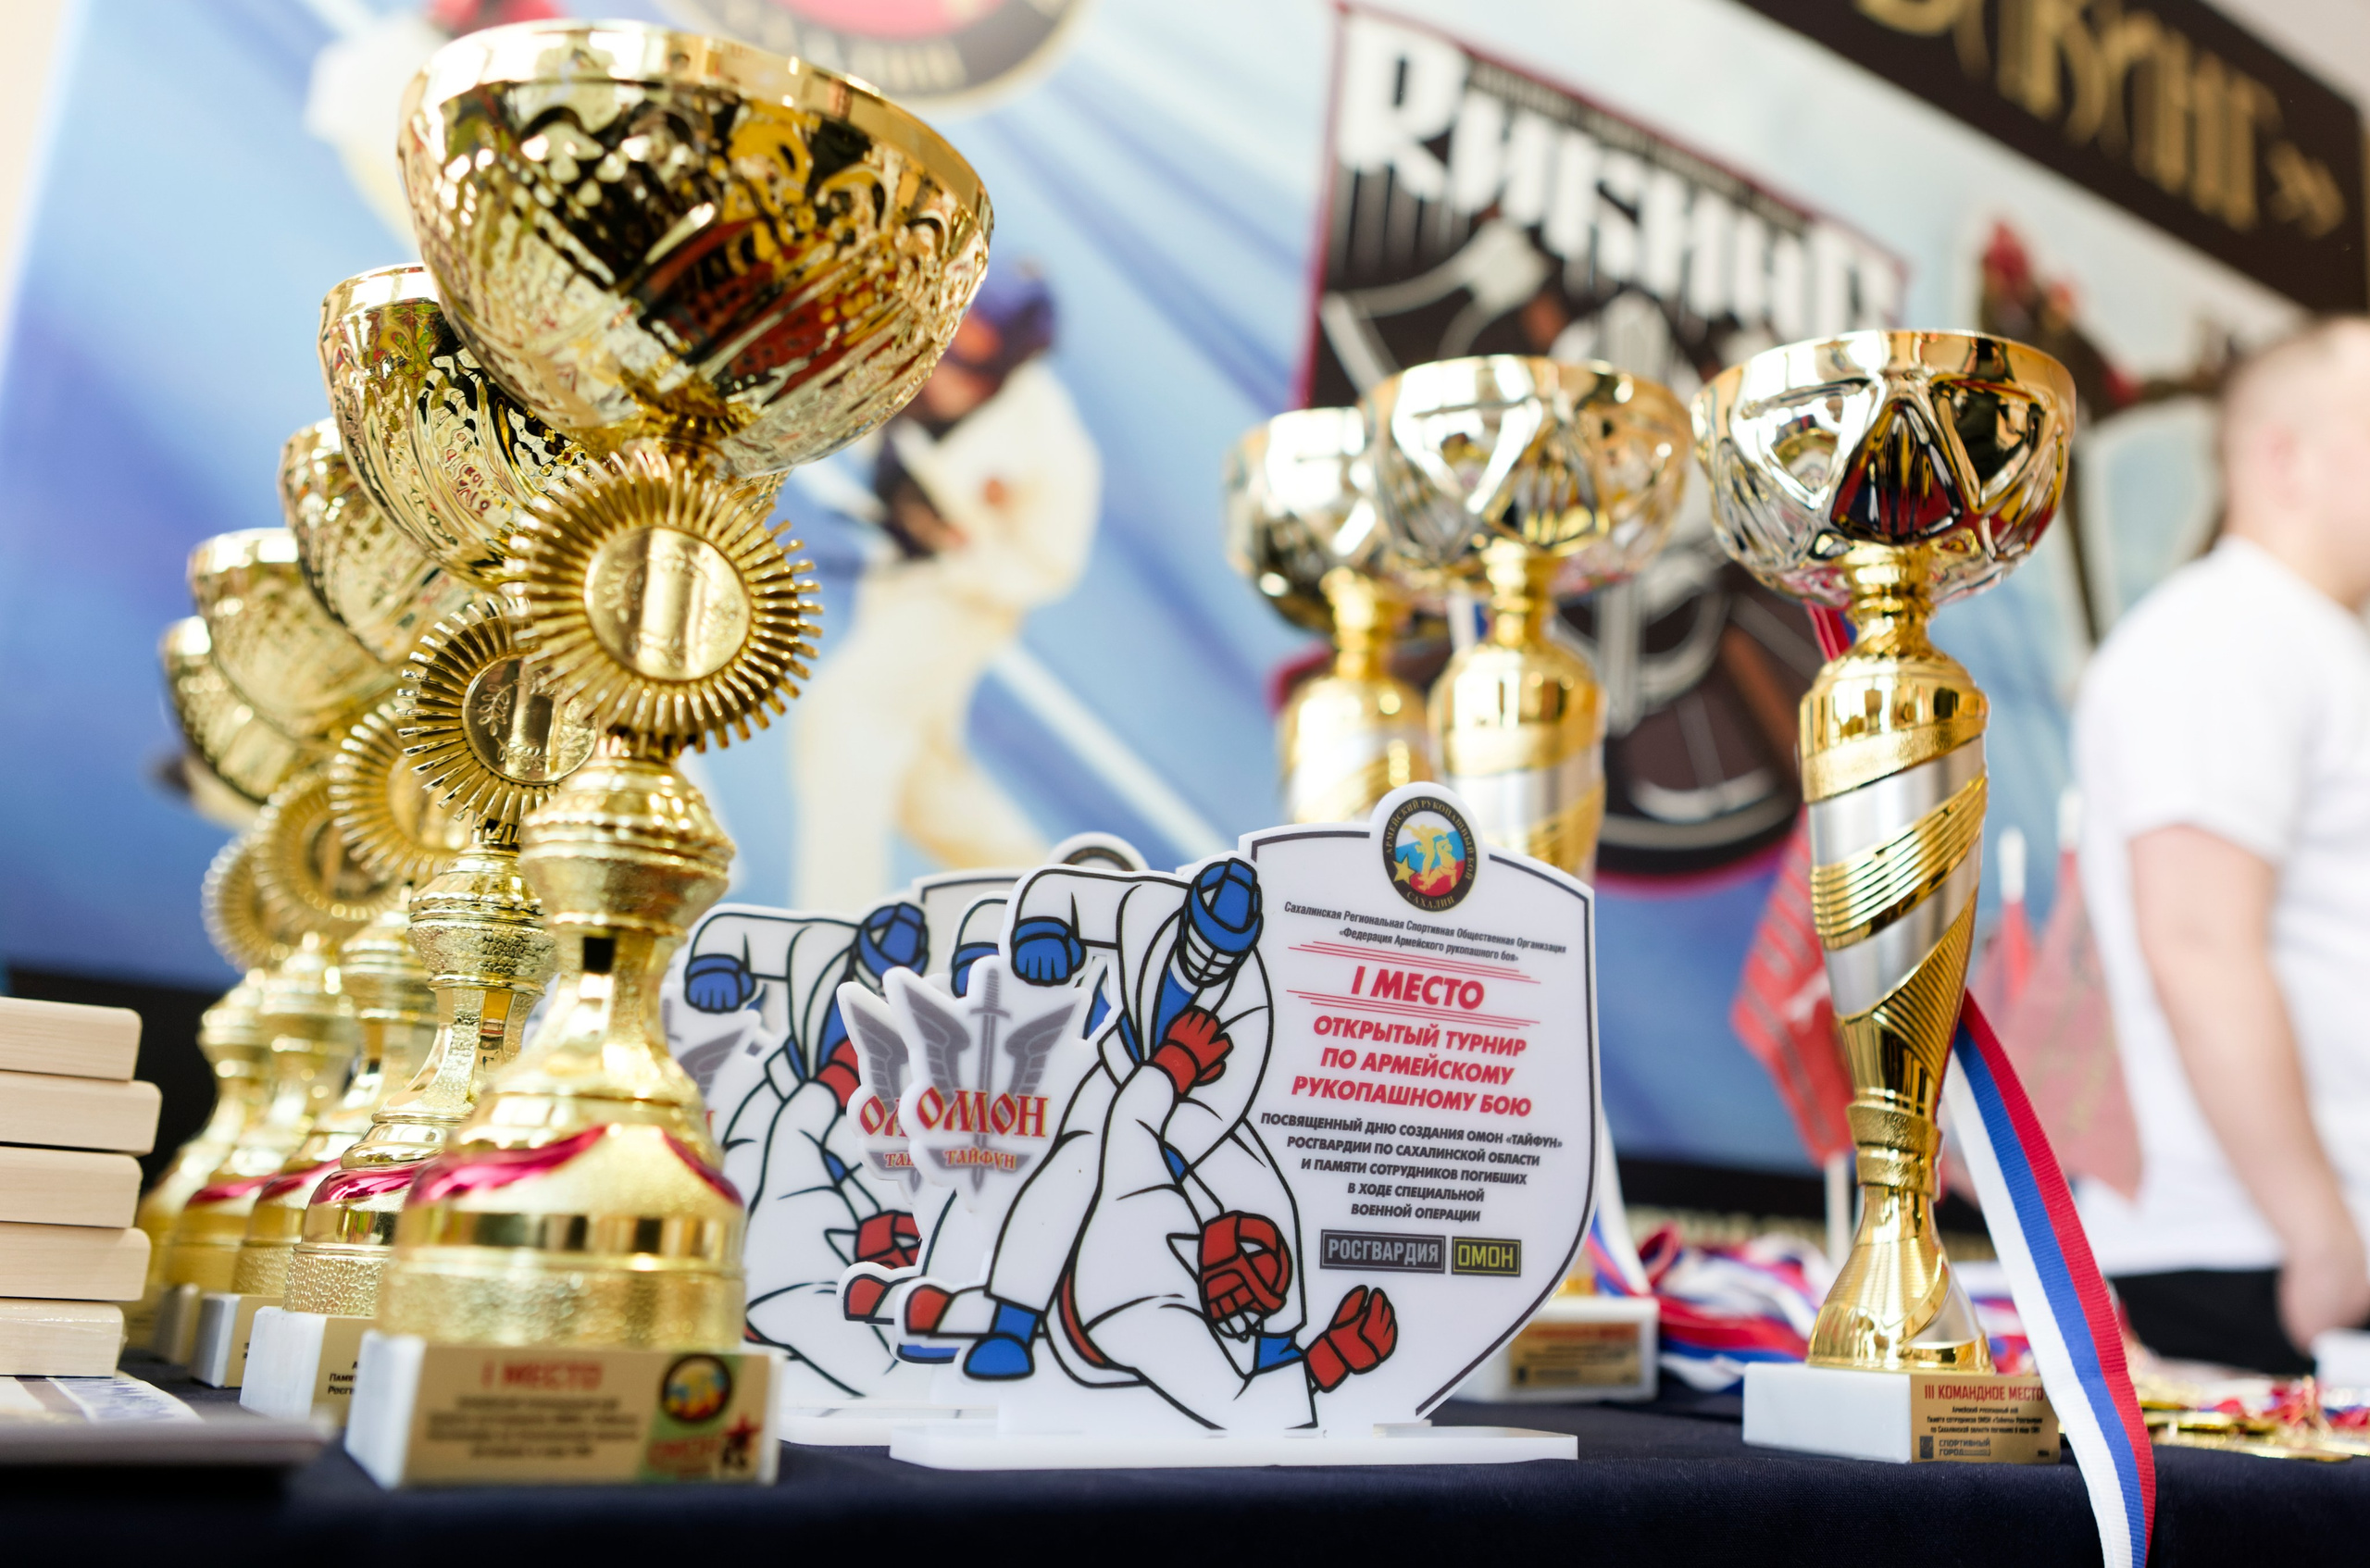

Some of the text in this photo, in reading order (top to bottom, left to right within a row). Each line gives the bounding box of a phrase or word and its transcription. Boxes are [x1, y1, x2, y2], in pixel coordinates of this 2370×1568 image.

[1407, 890, 1454, 908] САХАЛИН
[1285, 902, 1566, 953] Сахалинская Региональная Спортивная Общественная Организация
[1340, 927, 1519, 962] «Федерация Армейского рукопашного боя»
[1351, 965, 1485, 1010] I МЕСТО
[1314, 1014, 1527, 1057] ОТКРЫТЫЙ ТУРНИР
[1320, 1047, 1516, 1086] ПО АРМЕЙСКОМУ
[917, 1087, 1048, 1138] ОМОН
[1291, 1076, 1532, 1117] РУКОПАШНОМУ БОЮ
[1260, 1112, 1563, 1149] ПОСВЯЩЕННЫЙ ДНЮ СОЗДАНИЯ ОМОН «ТАЙФУН»
[944, 1147, 1017, 1169] ТАЙФУН
[1287, 1137, 1540, 1165] РОСГВАРДИИ ПО САХАЛИНСКОЙ ОБЛАСТИ
[1301, 1159, 1528, 1185] И ПАМЯТИ СОТРУДНИКОВ ПОГИБШИХ
[1348, 1183, 1485, 1202] В ХОДЕ СПЕЦИАЛЬНОЙ
[1351, 1203, 1481, 1222] ВОЕННОЙ ОПЕРАЦИИ
[1328, 1238, 1514, 1268] РОСГВАРДИЯ ОМОН
[1925, 1385, 2044, 1402] III КОМАНДНОЕ МЕСТО
